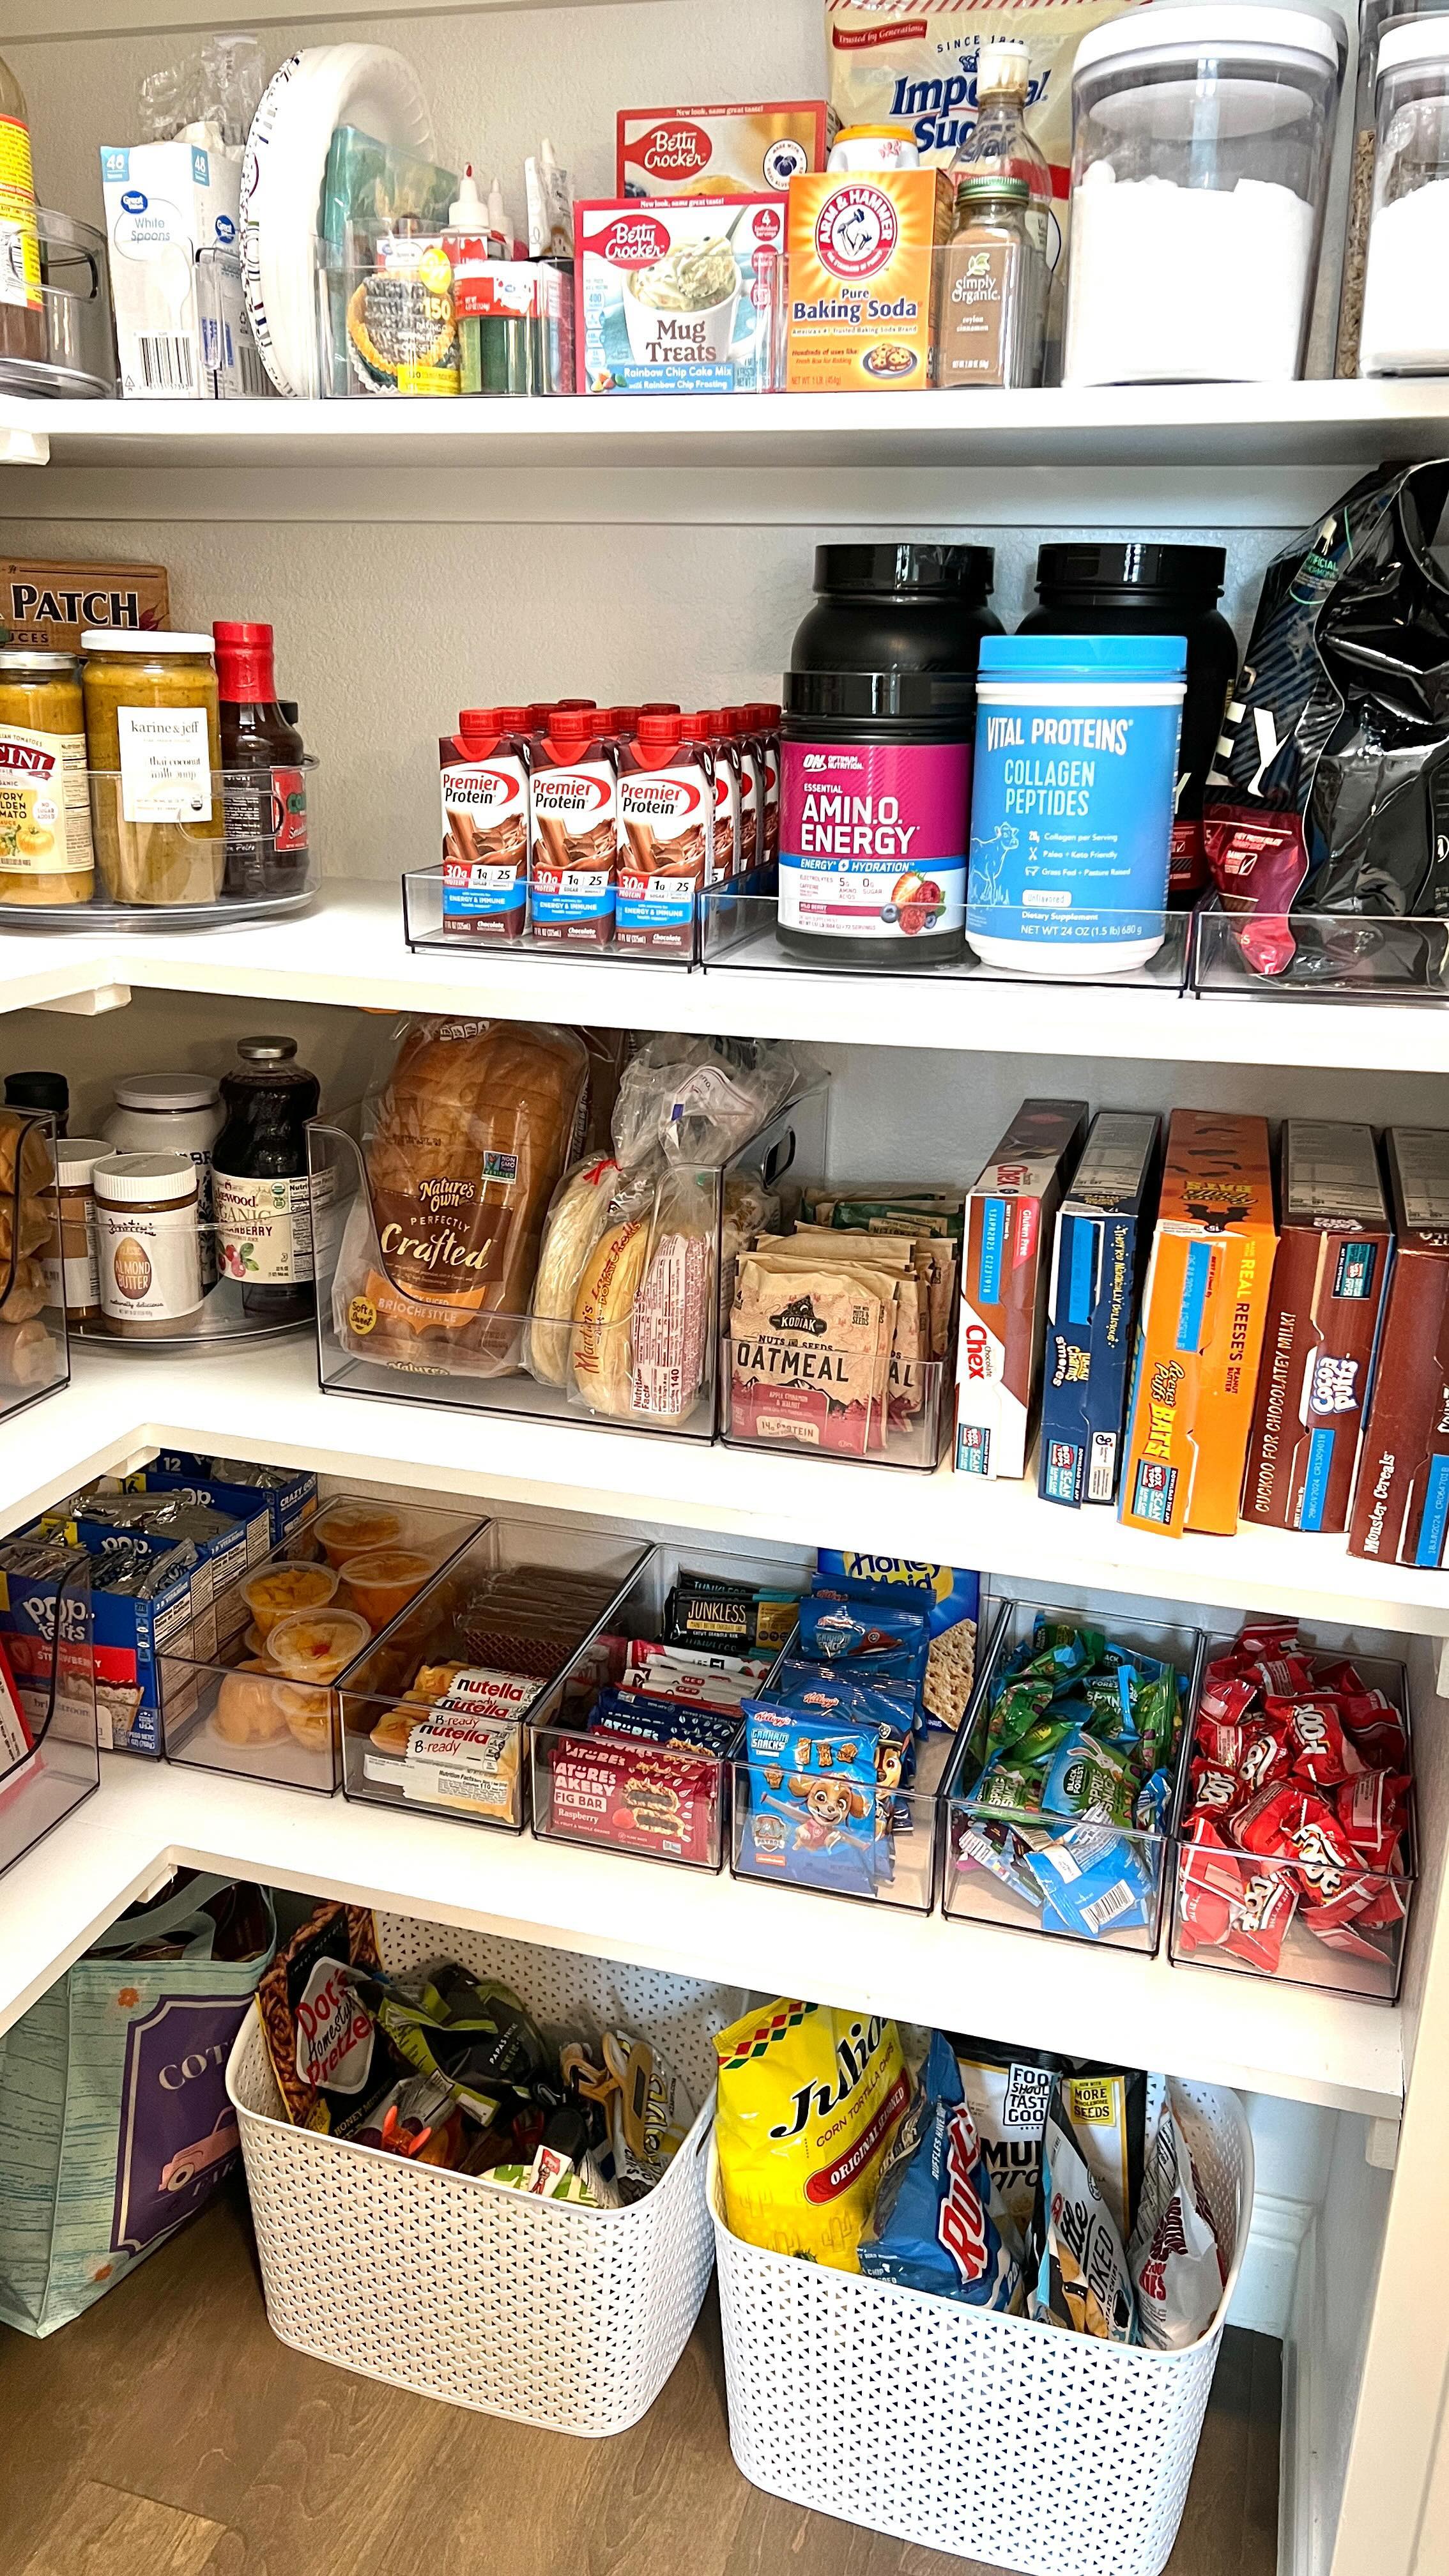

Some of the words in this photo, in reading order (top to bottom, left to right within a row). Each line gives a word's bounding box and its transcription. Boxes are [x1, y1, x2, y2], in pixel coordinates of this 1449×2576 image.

[838, 33, 865, 44] Trusted
[866, 32, 877, 43] by
[878, 24, 924, 39] Generations
[937, 34, 981, 53] SINCE
[889, 69, 1052, 119] Impal
[650, 130, 697, 153] Betty
[106, 153, 125, 170] 48
[194, 153, 206, 173] 48
[644, 147, 706, 169] Crocker
[135, 218, 165, 229] White
[762, 210, 771, 225] 4
[818, 201, 839, 243] ARM
[836, 196, 849, 210] &
[849, 190, 893, 241] HAMMER
[131, 231, 171, 243] Spoons
[611, 223, 656, 243] Betty
[605, 239, 665, 259] Crocker
[589, 293, 602, 302] 400
[841, 288, 870, 300] Pure
[422, 297, 451, 320] 150
[793, 301, 862, 323] Baking
[867, 298, 917, 318] Soda
[657, 319, 706, 342] Mug
[645, 342, 717, 363] Treats
[624, 367, 663, 378] Rainbow
[665, 367, 687, 378] Chip
[689, 366, 713, 377] Cake
[714, 366, 732, 376] Mix
[11, 583, 140, 629] PATCH
[131, 720, 171, 733] karine
[180, 720, 199, 736] jeff
[987, 717, 1025, 753] VITAL
[1031, 717, 1128, 756] PROTEINS
[443, 774, 501, 792] Premier
[1004, 758, 1095, 787] COLLAGEN
[445, 788, 493, 806] Protein
[533, 779, 593, 797] Premier
[621, 784, 682, 802] Premier
[804, 783, 843, 793] ESSENTIAL
[535, 793, 585, 811] Protein
[623, 798, 674, 816] Protein
[1005, 788, 1089, 816] PEPTIDES
[801, 824, 916, 855] ENERGY
[1044, 832, 1076, 842] Collagen
[1077, 834, 1091, 843] per
[1092, 833, 1118, 843] Serving
[497, 870, 510, 880] 25
[801, 859, 834, 870] ENERGY
[852, 862, 910, 873] HYDRATION
[449, 895, 473, 903] ENERGY
[477, 920, 505, 928] Chocolate
[1022, 912, 1048, 921] Dietary
[1050, 912, 1098, 922] Supplement
[567, 927, 596, 935] Chocolate
[652, 933, 682, 942] Chocolate
[1021, 925, 1039, 935] NET
[1042, 926, 1058, 935] WT
[1060, 927, 1072, 936] 24
[1075, 928, 1089, 936] OZ
[1091, 927, 1107, 937] (1.5
[1121, 926, 1136, 935] 680
[997, 1164, 1029, 1186] Chex
[420, 1177, 475, 1201] Nature's
[430, 1195, 461, 1213] Own
[410, 1215, 471, 1233] PERFECTLY
[1022, 1209, 1032, 1238] Gluten
[381, 1222, 492, 1270] Crafted
[1019, 1238, 1031, 1257] Free
[116, 1261, 151, 1275] ALMOND
[118, 1275, 149, 1290] BUTTER
[1237, 1259, 1256, 1299] REAL
[378, 1298, 426, 1320] BRIOCHE
[427, 1309, 457, 1323] STYLE
[781, 1316, 816, 1332] KODIAK
[852, 1317, 869, 1326] SEEDS
[1229, 1302, 1250, 1361] REESE'S
[1278, 1311, 1296, 1350] MILK!
[575, 1303, 599, 1375] Martin's
[758, 1335, 785, 1346] NUTS
[965, 1324, 987, 1379] Chex
[983, 1345, 993, 1377] Chocolate
[737, 1342, 849, 1383] OATMEAL
[1066, 1346, 1080, 1382] Charms
[1151, 1362, 1168, 1401] Puffs
[1224, 1367, 1232, 1393] BUTTER
[1232, 1367, 1241, 1394] PEANUT
[1311, 1356, 1339, 1414] Cocoa
[641, 1384, 650, 1409] Facts
[1266, 1349, 1290, 1434] CHOCOLATEY
[971, 1428, 980, 1445] BOX
[1142, 1404, 1177, 1460] BATS
[1061, 1445, 1071, 1468] BOX
[1263, 1434, 1278, 1462] FOR
[162, 1457, 181, 1472] 12
[971, 1448, 981, 1473] SCAN
[1061, 1470, 1072, 1498] SCAN
[1153, 1466, 1164, 1490] BOX
[1168, 1469, 1177, 1501] DOWNLOAD
[1372, 1451, 1396, 1500] Cereals
[280, 1488, 303, 1506] CRAZY
[1254, 1463, 1276, 1512] CUCKOO
[1153, 1491, 1163, 1520] SCAN
[1363, 1502, 1387, 1555] Monster
[848, 1552, 940, 1579] Honey
[688, 1600, 747, 1623] JUNKLESS
[38, 1621, 86, 1643] tats
[457, 1678, 524, 1701] nutella
[803, 1692, 839, 1707] Kellogg's
[442, 1699, 509, 1718] nutella
[755, 1711, 792, 1726] Kellogg's
[418, 1724, 490, 1745] nutella
[750, 1736, 786, 1752] SNACKS
[751, 1727, 790, 1743] GRAHAM
[439, 1769, 460, 1779] Nutrition
[460, 1774, 474, 1782] Facts
[1066, 1768, 1077, 1793] BLACK
[1073, 1765, 1085, 1794] FOREST
[555, 1791, 575, 1804] FIG
[578, 1795, 602, 1809] BAR
[558, 1808, 599, 1825] Raspberry
[756, 1837, 785, 1846] PATROL
[489, 2037, 507, 2066] PAPAS
[815, 2120, 848, 2148] CORN
[847, 2069, 880, 2120] TORTILLA
[879, 2041, 894, 2071] CHIPS
[1011, 2082, 1050, 2096] SHOUL
[1074, 2087, 1107, 2101] MORE
[1010, 2095, 1046, 2109] TAST
[1073, 2106, 1110, 2119] SEEDS
[334, 2110, 362, 2138] HONEY
[934, 2114, 944, 2137] HAVE
[830, 2131, 880, 2186] ORIGINAL
[931, 2136, 942, 2182] RUFFLES
